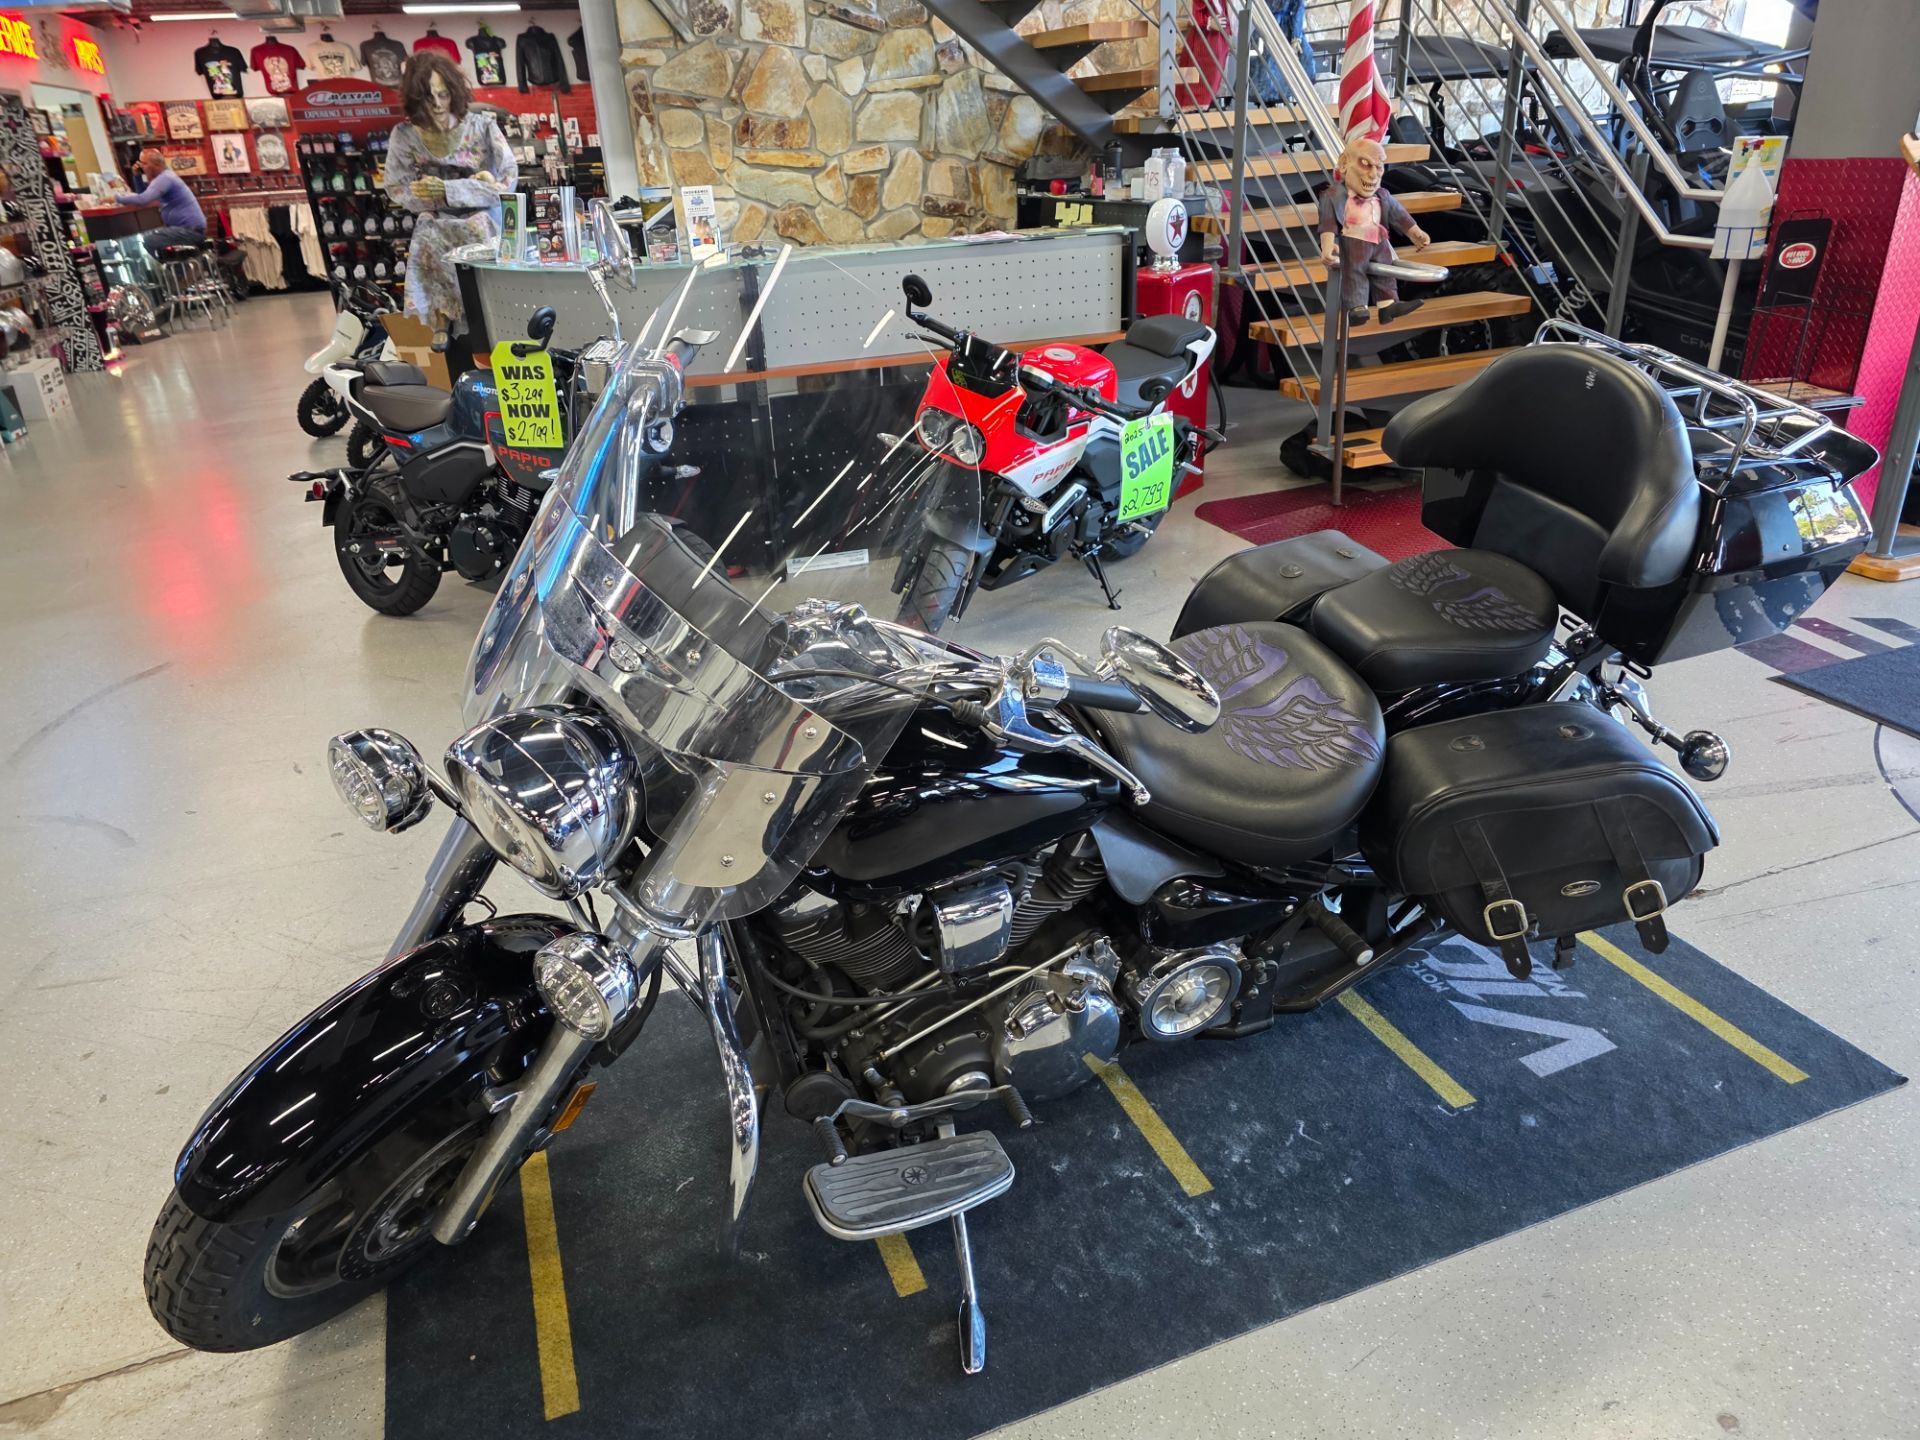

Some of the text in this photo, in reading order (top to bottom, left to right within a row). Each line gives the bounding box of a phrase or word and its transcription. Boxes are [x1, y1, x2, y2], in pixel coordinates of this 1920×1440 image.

[328, 92, 381, 101] MAXIMA
[304, 107, 390, 118] EXPERIENCE THE DIFFERENCE
[28, 201, 65, 272] Muc-Off
[1681, 334, 1743, 360] CFMTO
[501, 366, 545, 380] WAS
[507, 404, 550, 418] NOW
[1124, 427, 1145, 444] 2025
[1126, 428, 1169, 479] SALE
[1122, 482, 1164, 516] $2,799
